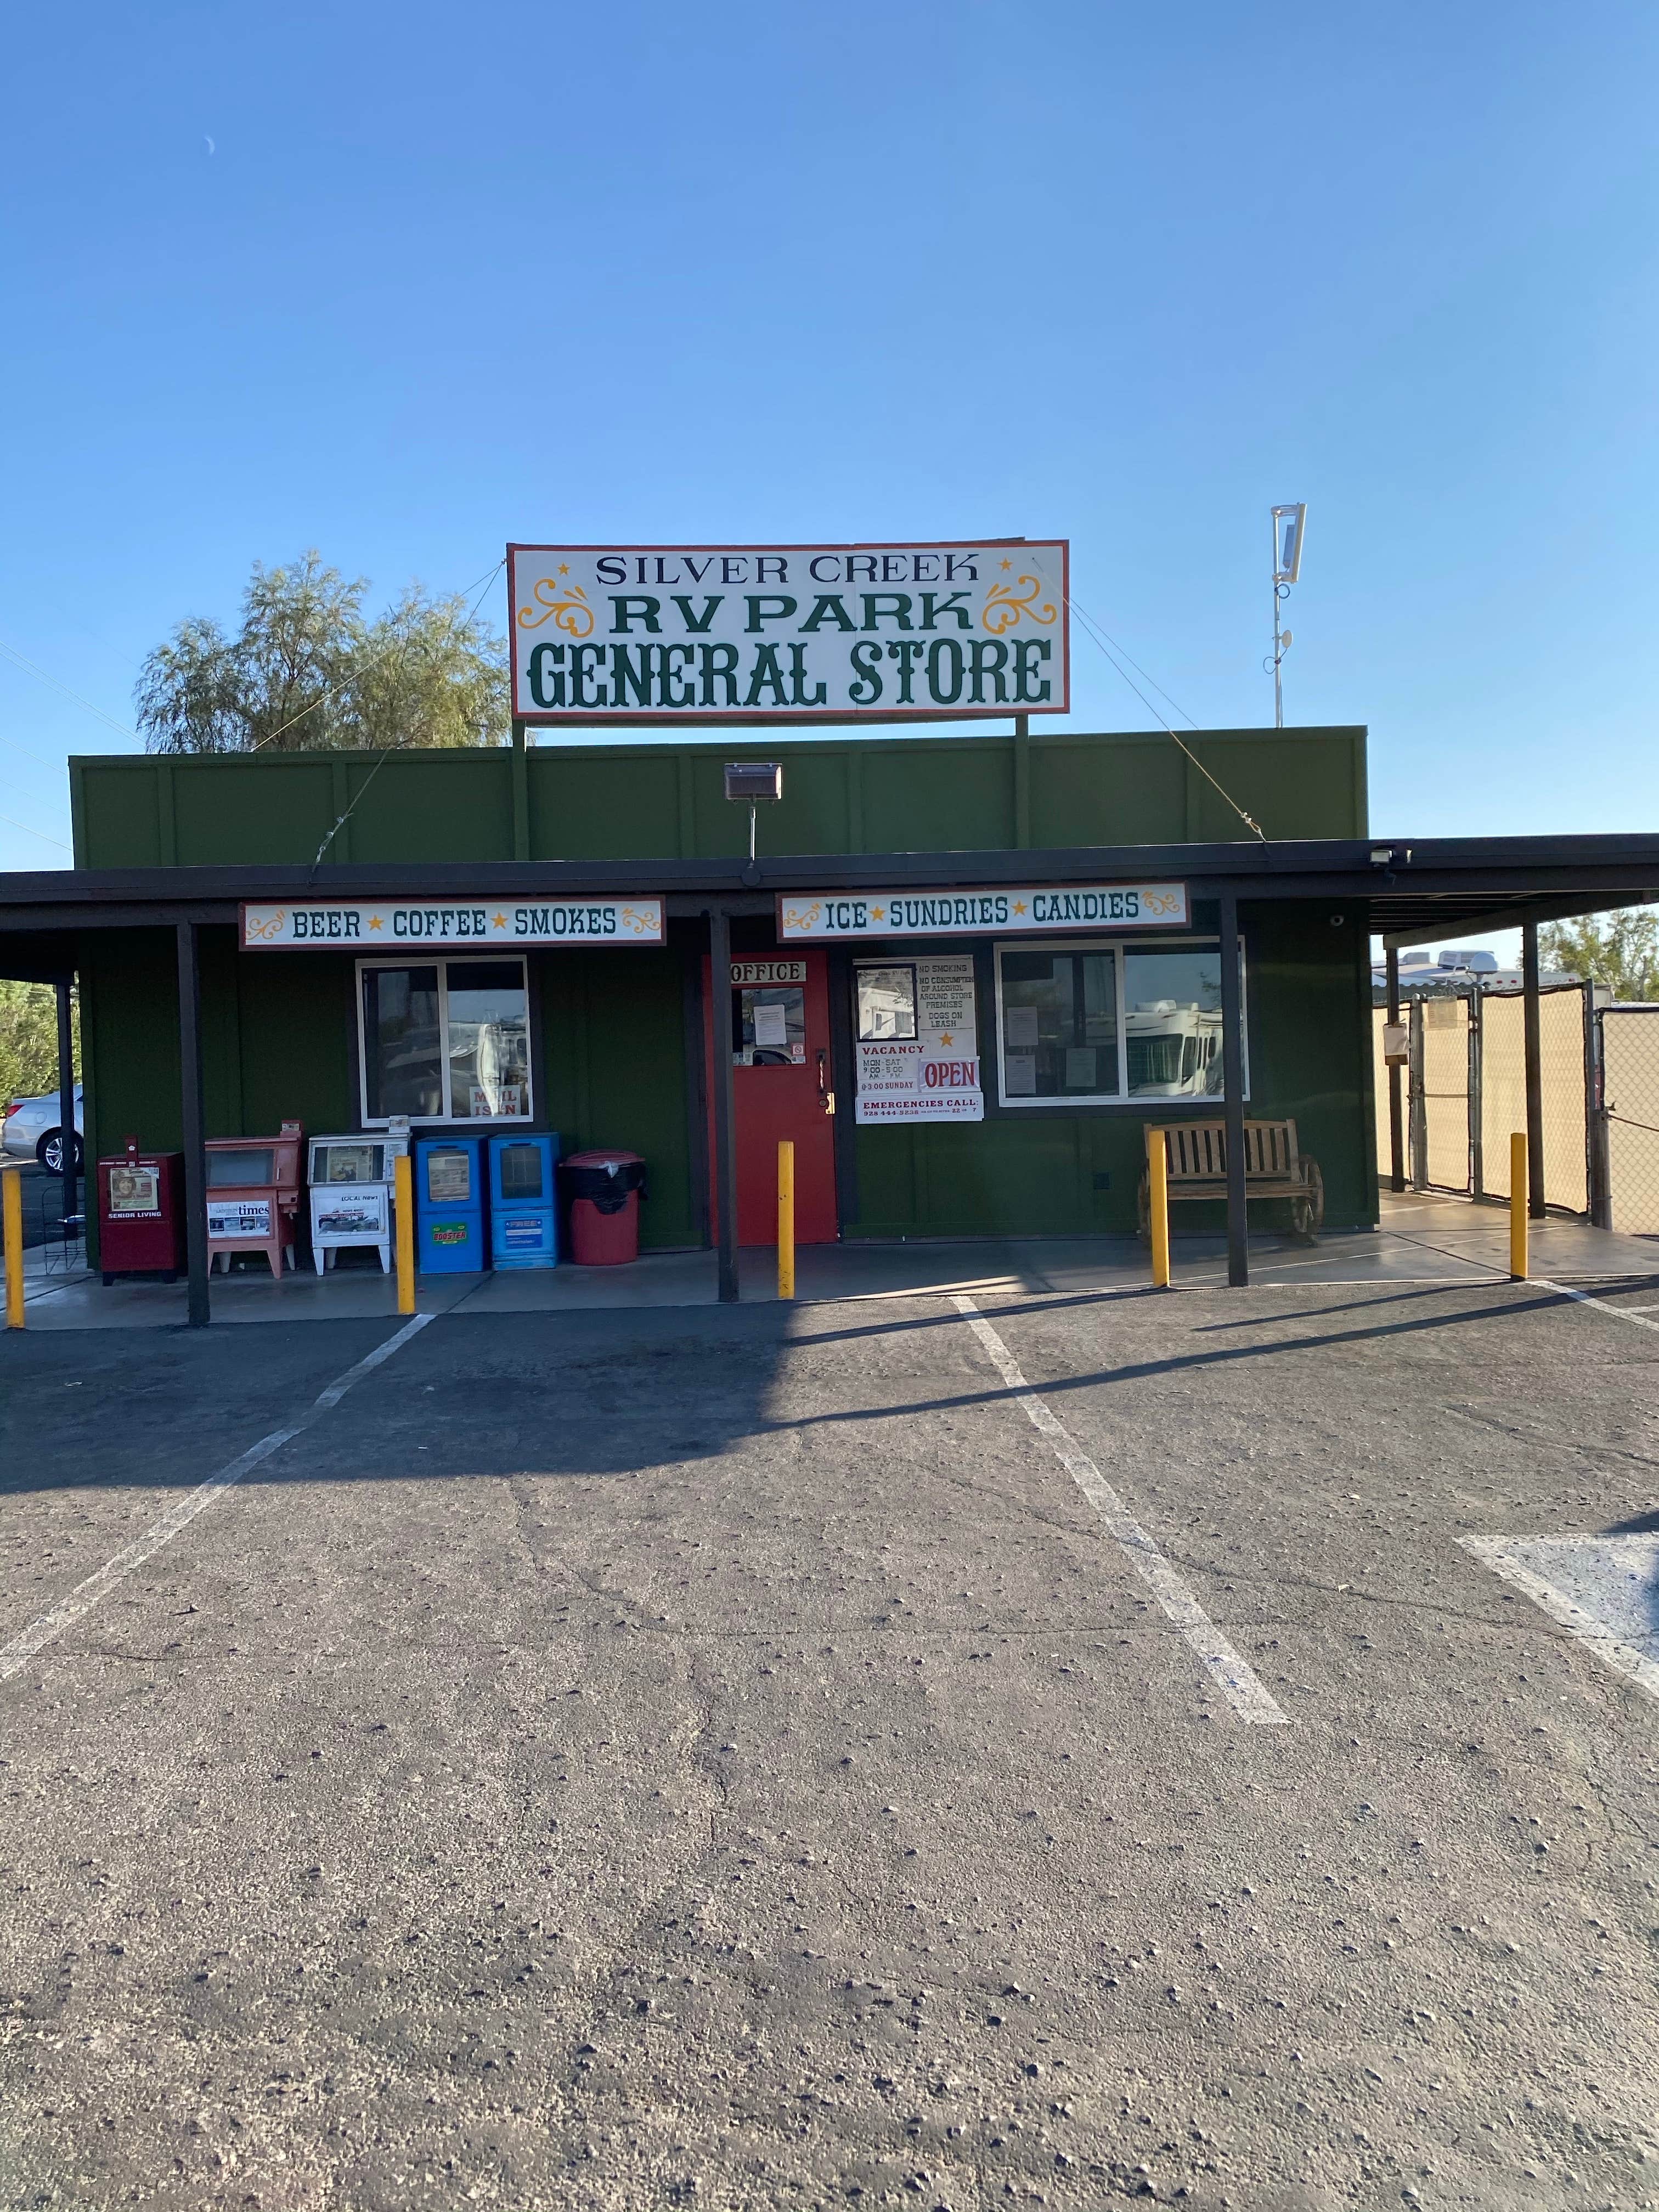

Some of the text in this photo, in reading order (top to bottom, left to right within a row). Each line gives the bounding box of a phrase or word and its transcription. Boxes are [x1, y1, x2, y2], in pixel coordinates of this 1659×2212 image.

[596, 554, 979, 585] SILVER CREEK
[608, 592, 974, 634] RV PARK
[527, 639, 1052, 708] GENERAL STORE
[292, 907, 617, 938] BEER COFFEE SMOKES
[825, 892, 1139, 929] ICE SUNDRIES CANDIES
[731, 963, 800, 981] OFFICE
[862, 1046, 925, 1055] VACANCY
[925, 1062, 975, 1088] OPEN
[474, 1091, 517, 1102] MIL
[864, 1100, 943, 1109] EMERGENCIES
[238, 1205, 269, 1215] times
